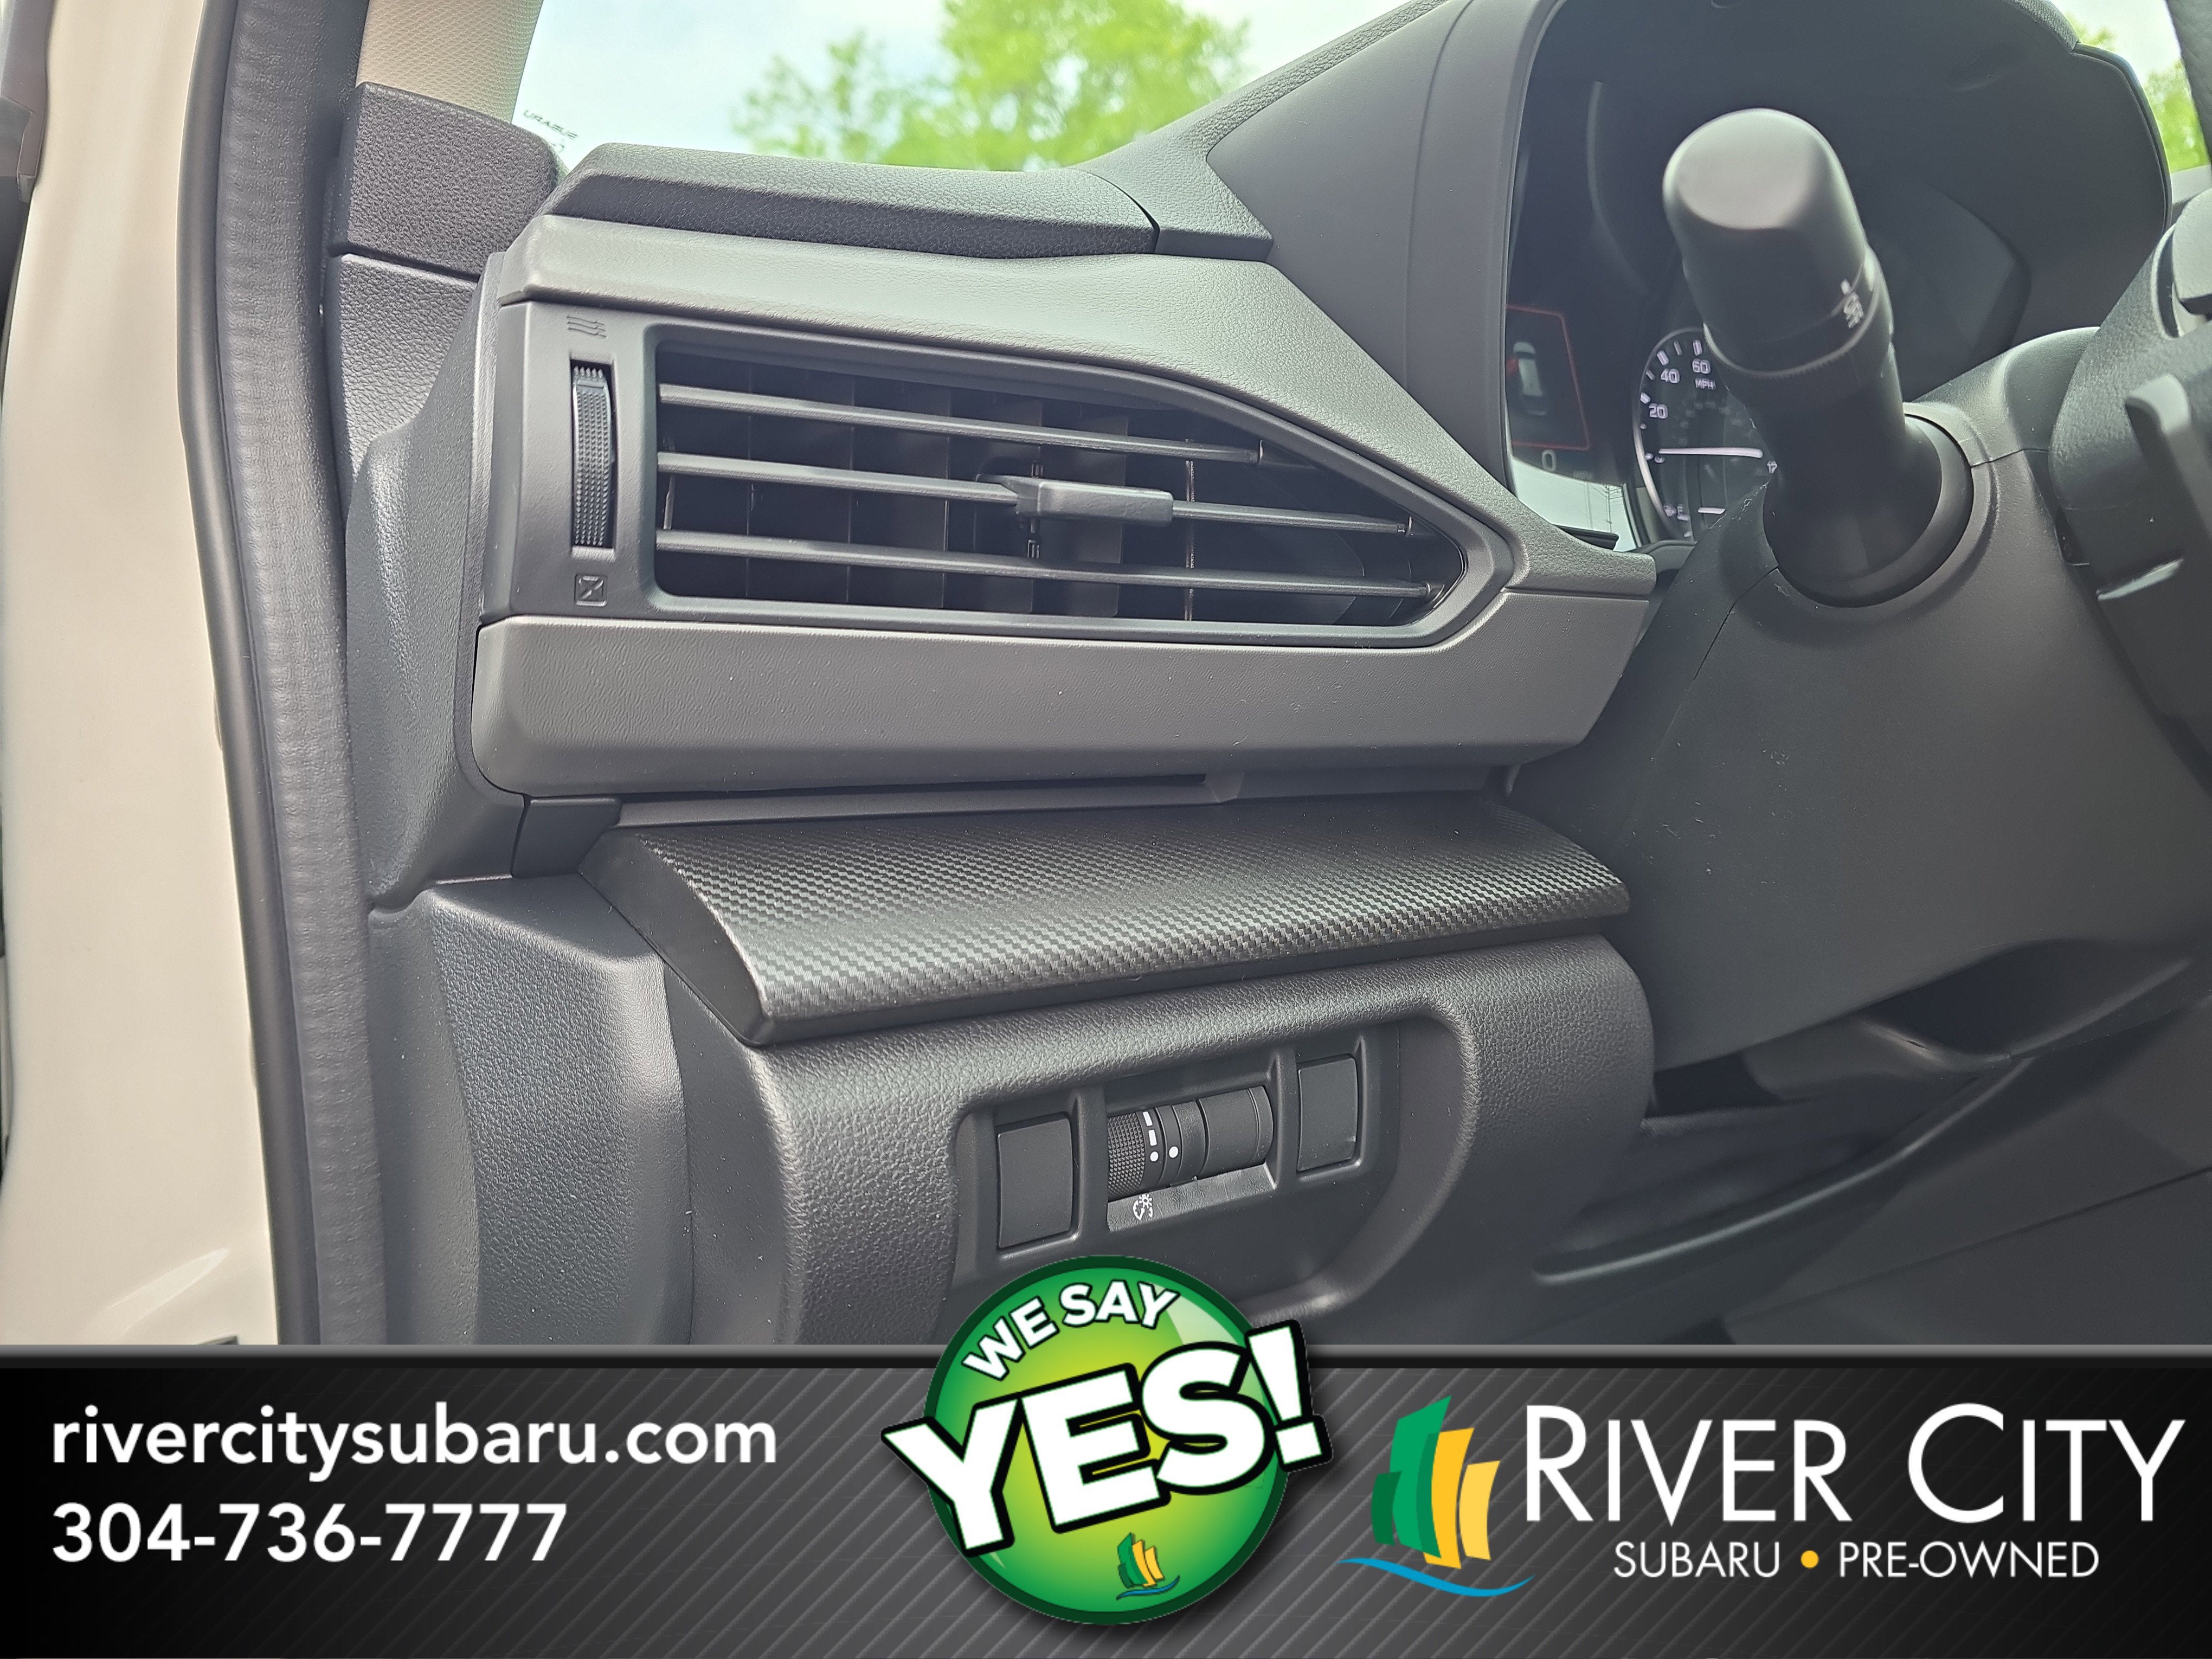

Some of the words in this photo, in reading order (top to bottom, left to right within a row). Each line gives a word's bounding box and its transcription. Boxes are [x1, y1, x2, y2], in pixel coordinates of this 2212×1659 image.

[1692, 358, 1711, 374] 60
[1660, 368, 1681, 384] 40
[1695, 378, 1716, 390] MPH
[1649, 403, 1668, 419] 20
[1541, 449, 1557, 472] 0
